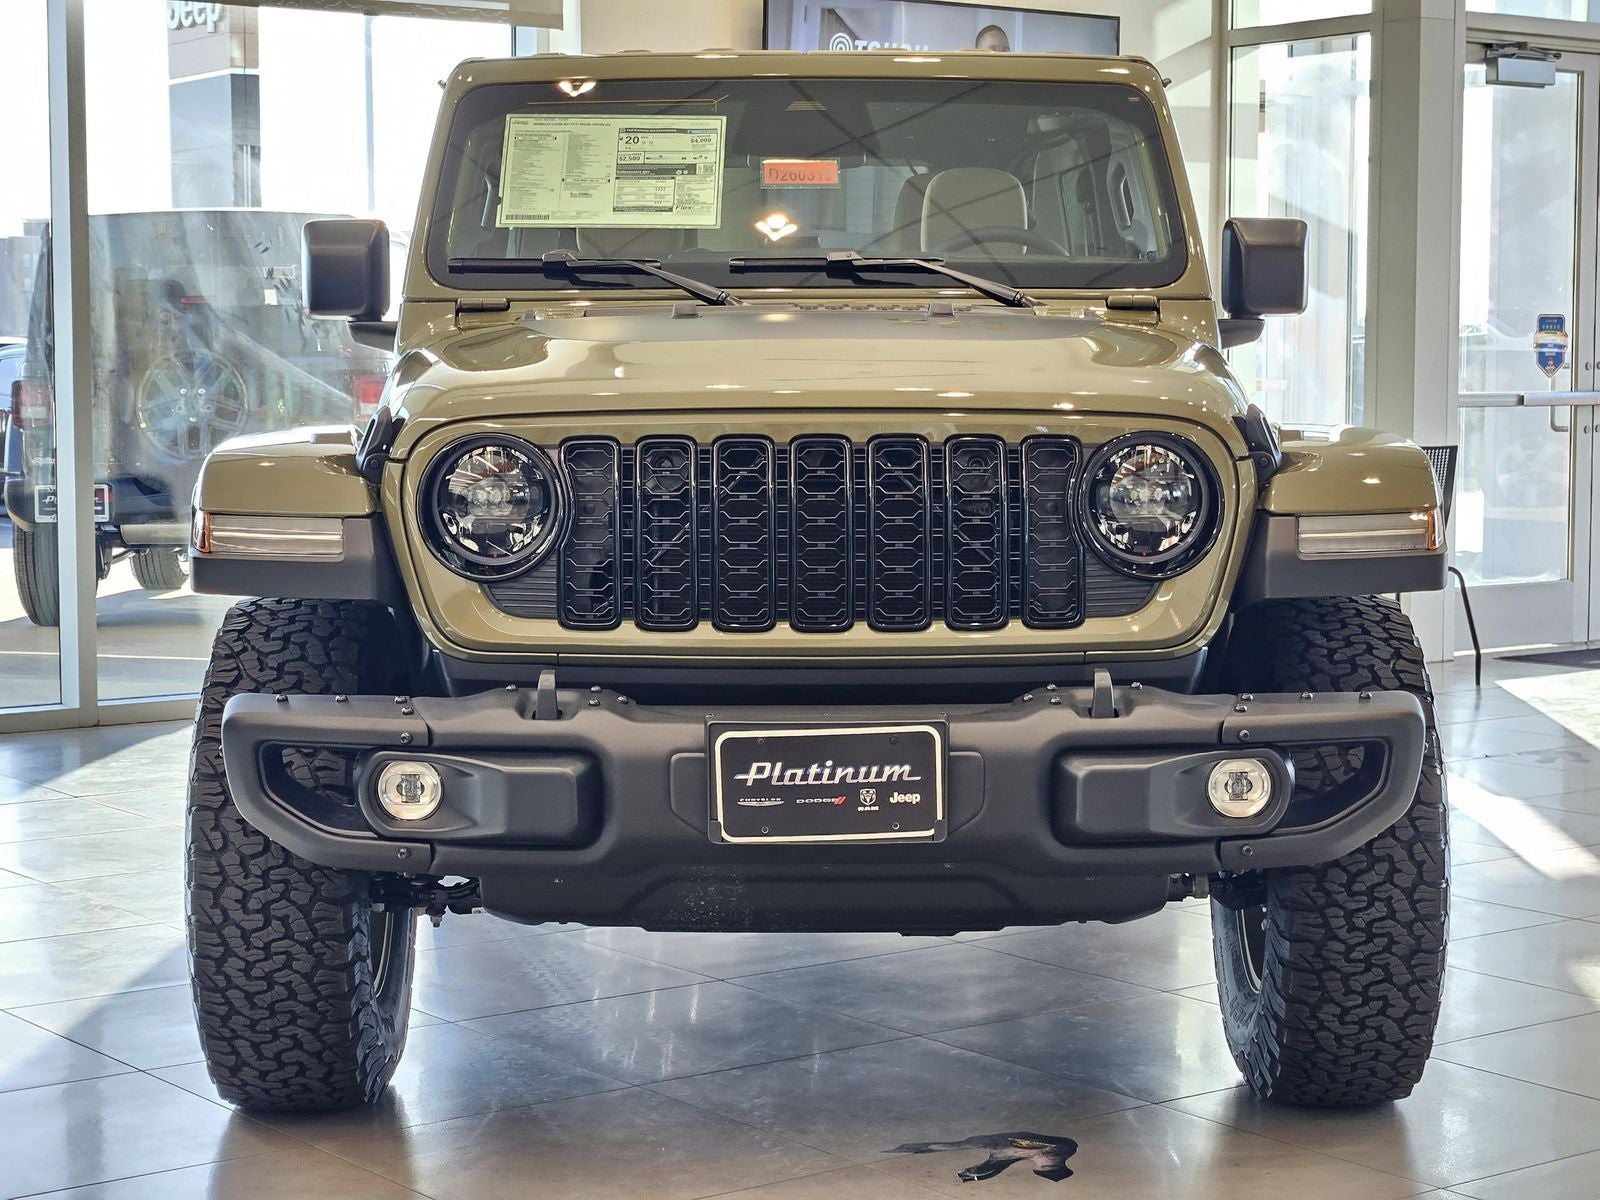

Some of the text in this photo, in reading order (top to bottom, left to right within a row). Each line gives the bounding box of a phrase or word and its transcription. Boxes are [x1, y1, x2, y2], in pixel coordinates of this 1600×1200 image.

[167, 0, 221, 33] Jeep
[625, 135, 640, 145] 20
[733, 760, 921, 787] Platinum
[889, 791, 921, 804] Jeep
